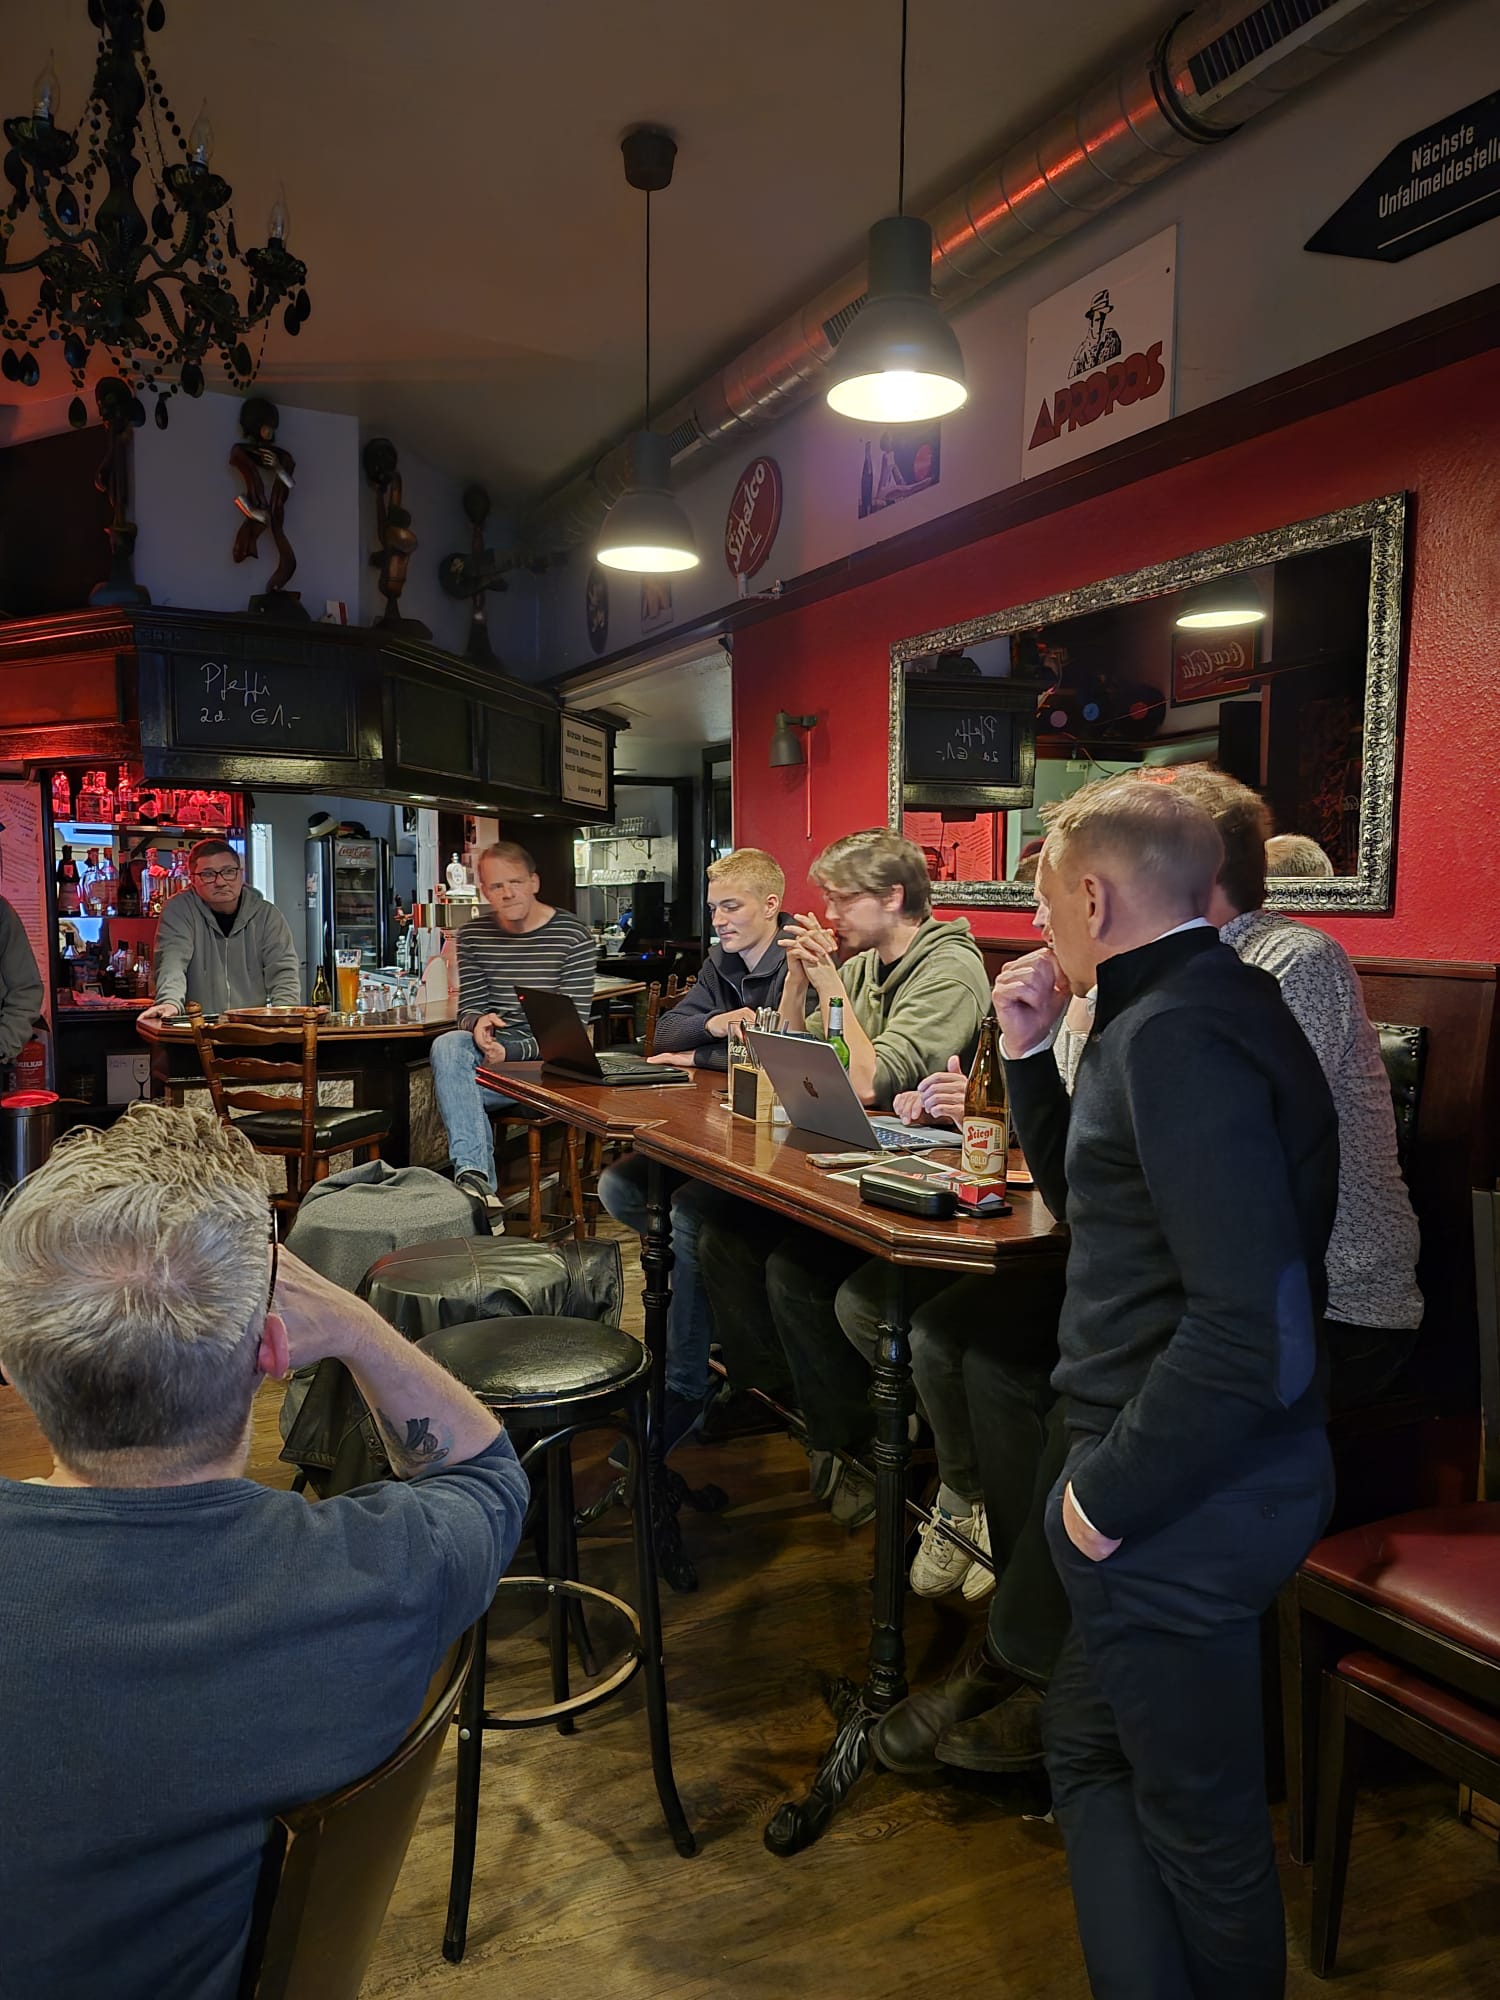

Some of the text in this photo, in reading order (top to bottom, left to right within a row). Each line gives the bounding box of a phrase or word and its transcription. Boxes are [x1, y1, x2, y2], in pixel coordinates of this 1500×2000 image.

[1411, 124, 1474, 174] Nächste
[1028, 340, 1165, 451] APROPOS
[728, 463, 765, 573] Sinalco
[967, 1126, 994, 1142] Stiegl
